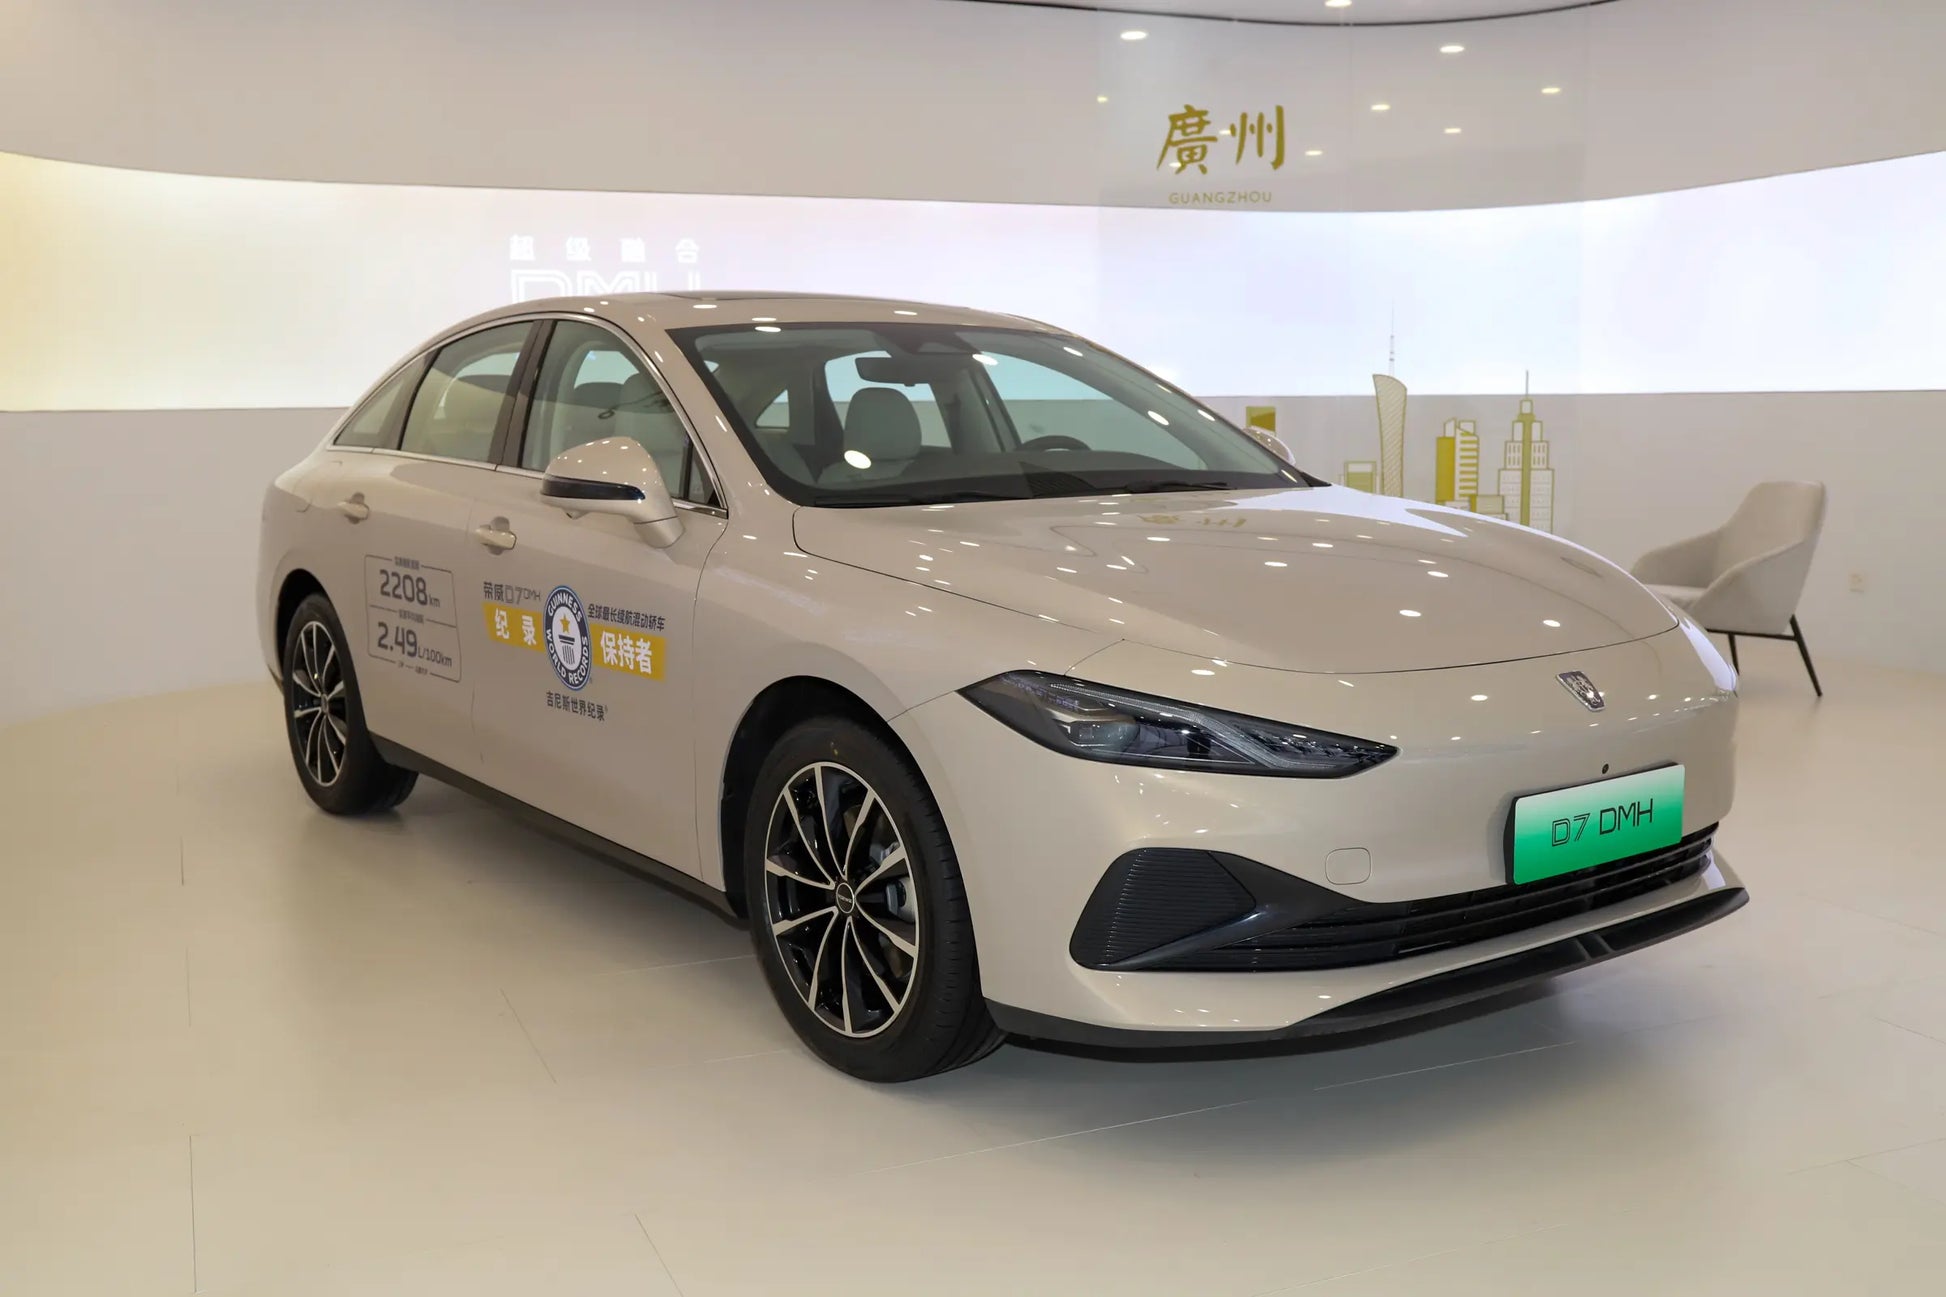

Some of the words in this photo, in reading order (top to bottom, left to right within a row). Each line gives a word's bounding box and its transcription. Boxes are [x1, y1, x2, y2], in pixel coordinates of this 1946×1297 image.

[1156, 104, 1285, 175] 廣州
[1168, 191, 1273, 204] GUANGZHOU
[547, 592, 583, 622] GUINNESS
[587, 603, 666, 632] 全球最长续航混动轿车
[546, 629, 567, 678] WORLD
[568, 636, 589, 684] RECORDS
[600, 630, 652, 675] 保持者
[1552, 812, 1591, 847] D7
[1600, 798, 1653, 836] DMH
